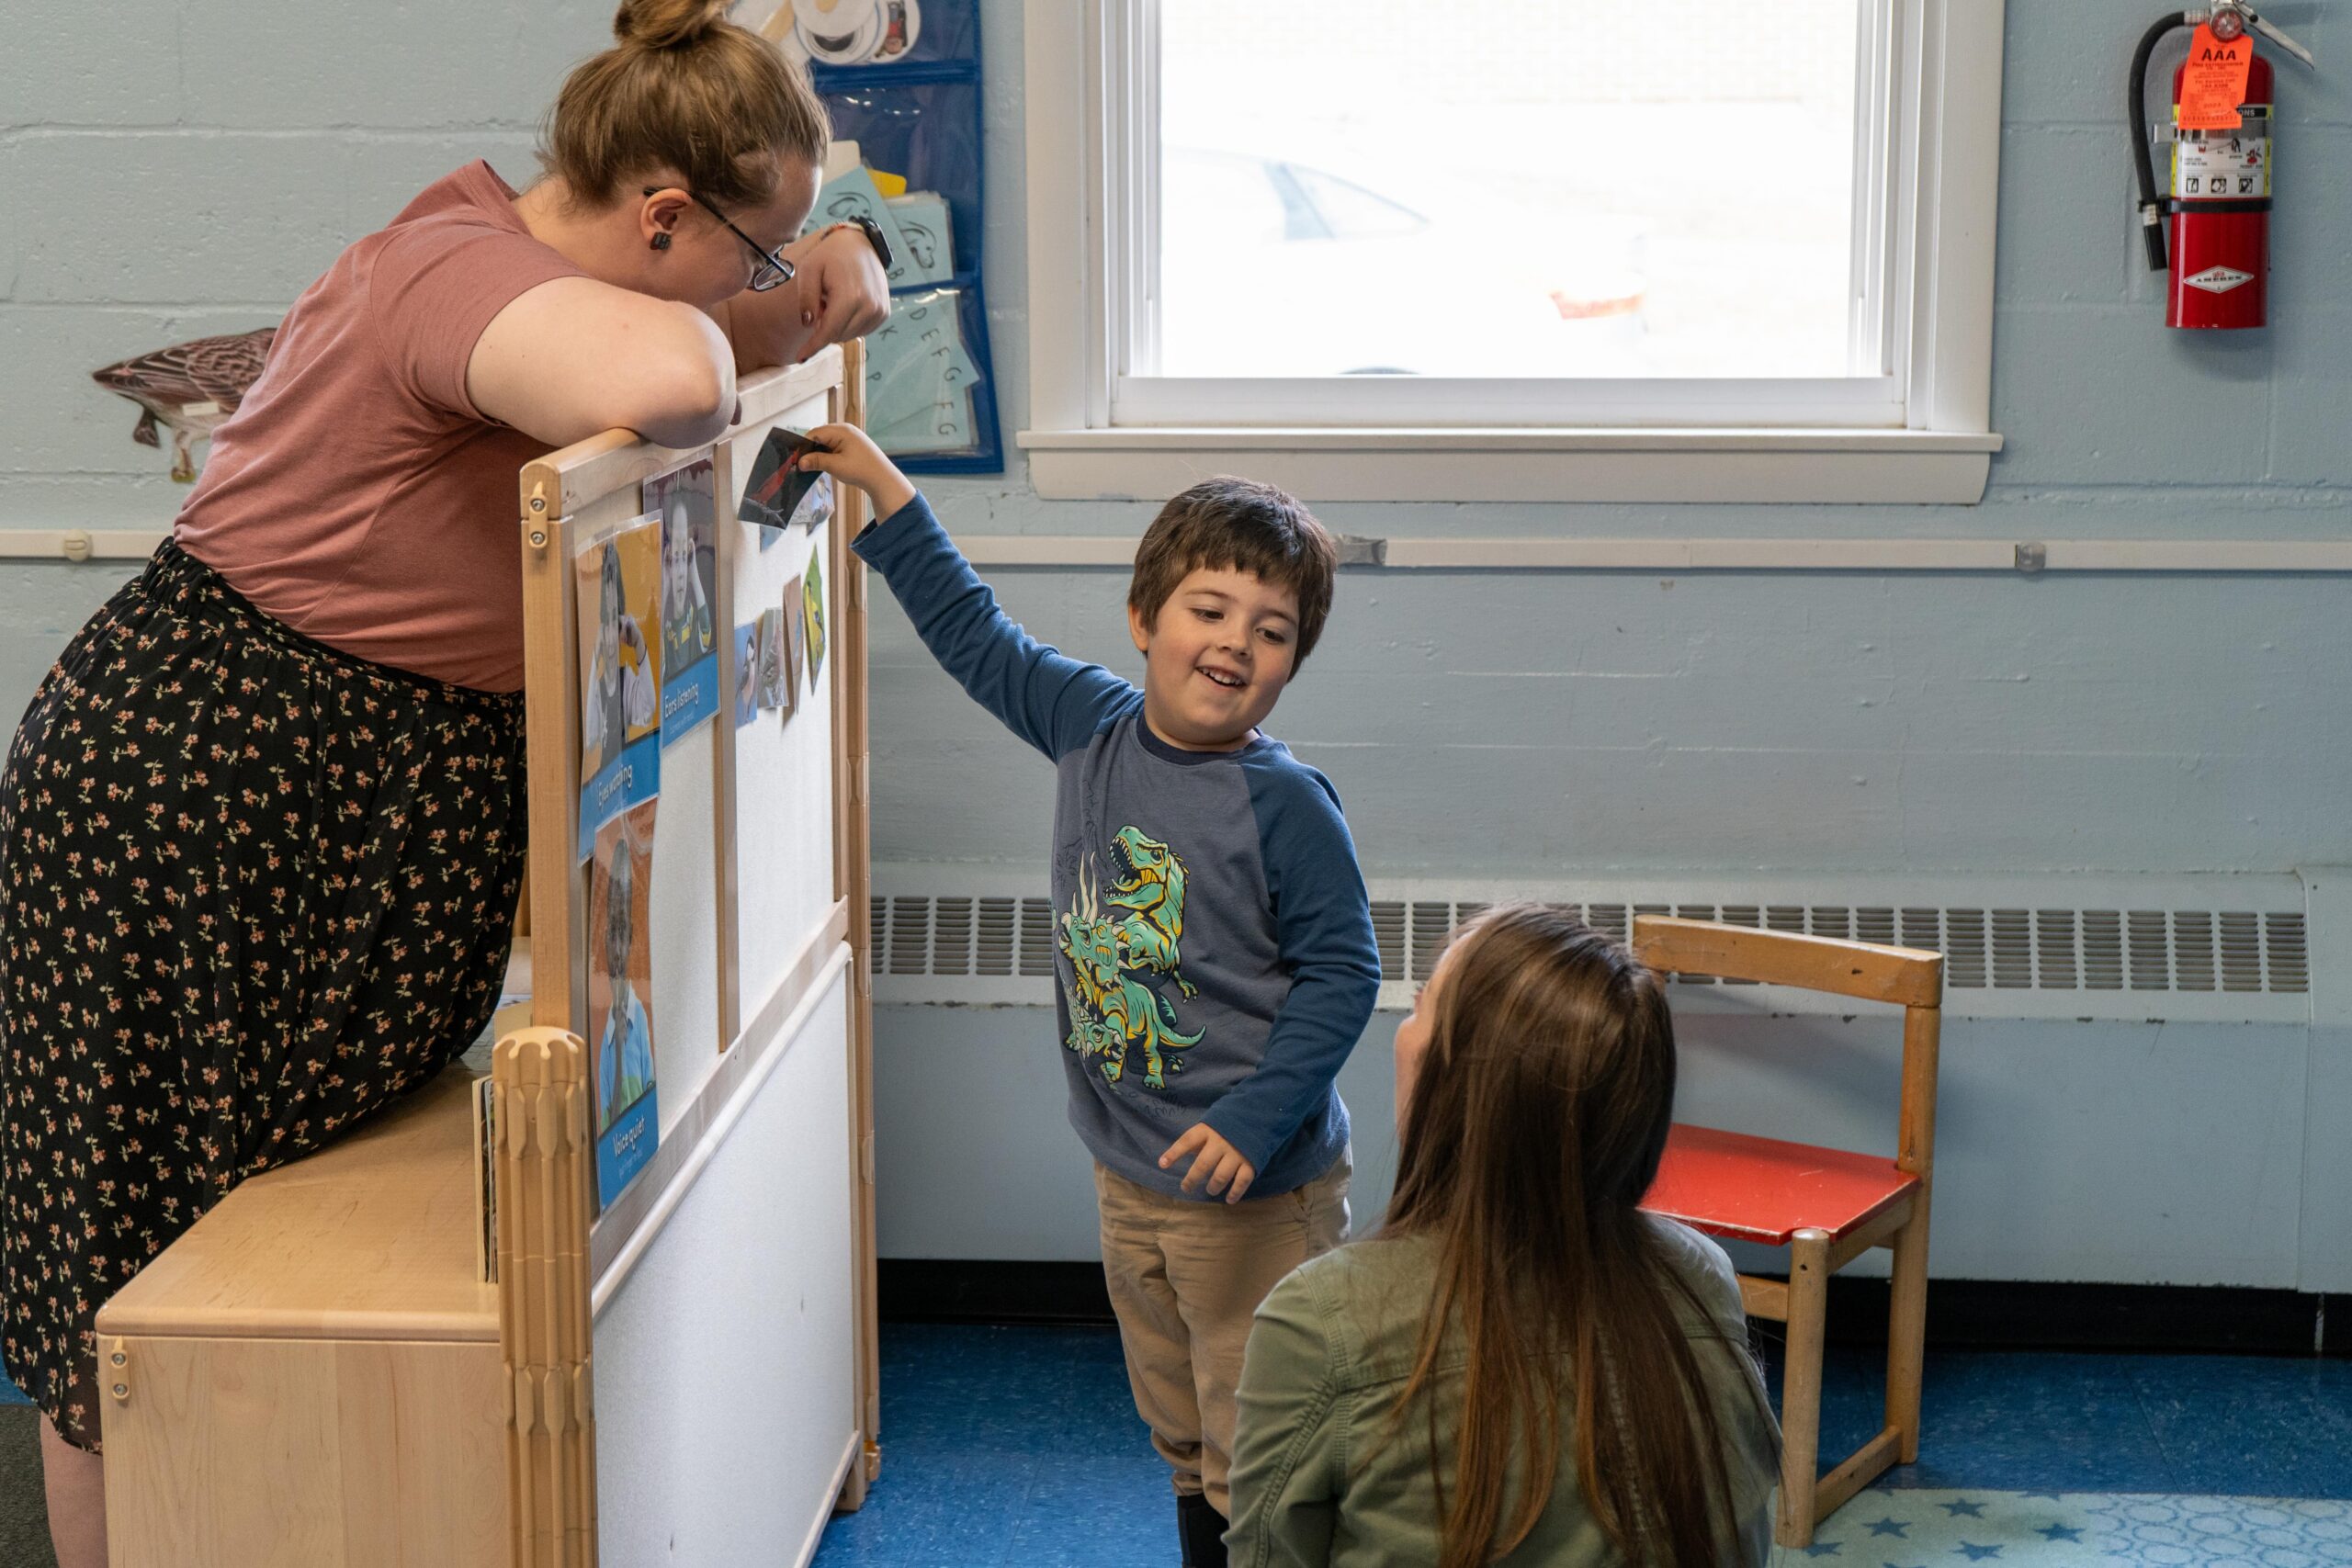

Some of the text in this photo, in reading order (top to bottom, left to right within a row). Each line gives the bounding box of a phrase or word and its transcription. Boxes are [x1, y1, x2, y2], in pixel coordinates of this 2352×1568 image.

[2201, 48, 2236, 61] AAA
[888, 266, 905, 279] B
[878, 324, 899, 340] K
[909, 307, 962, 382] D E F G
[938, 422, 957, 436] G
[664, 682, 699, 718] Ears listening
[613, 1116, 645, 1156] Voice quiet
